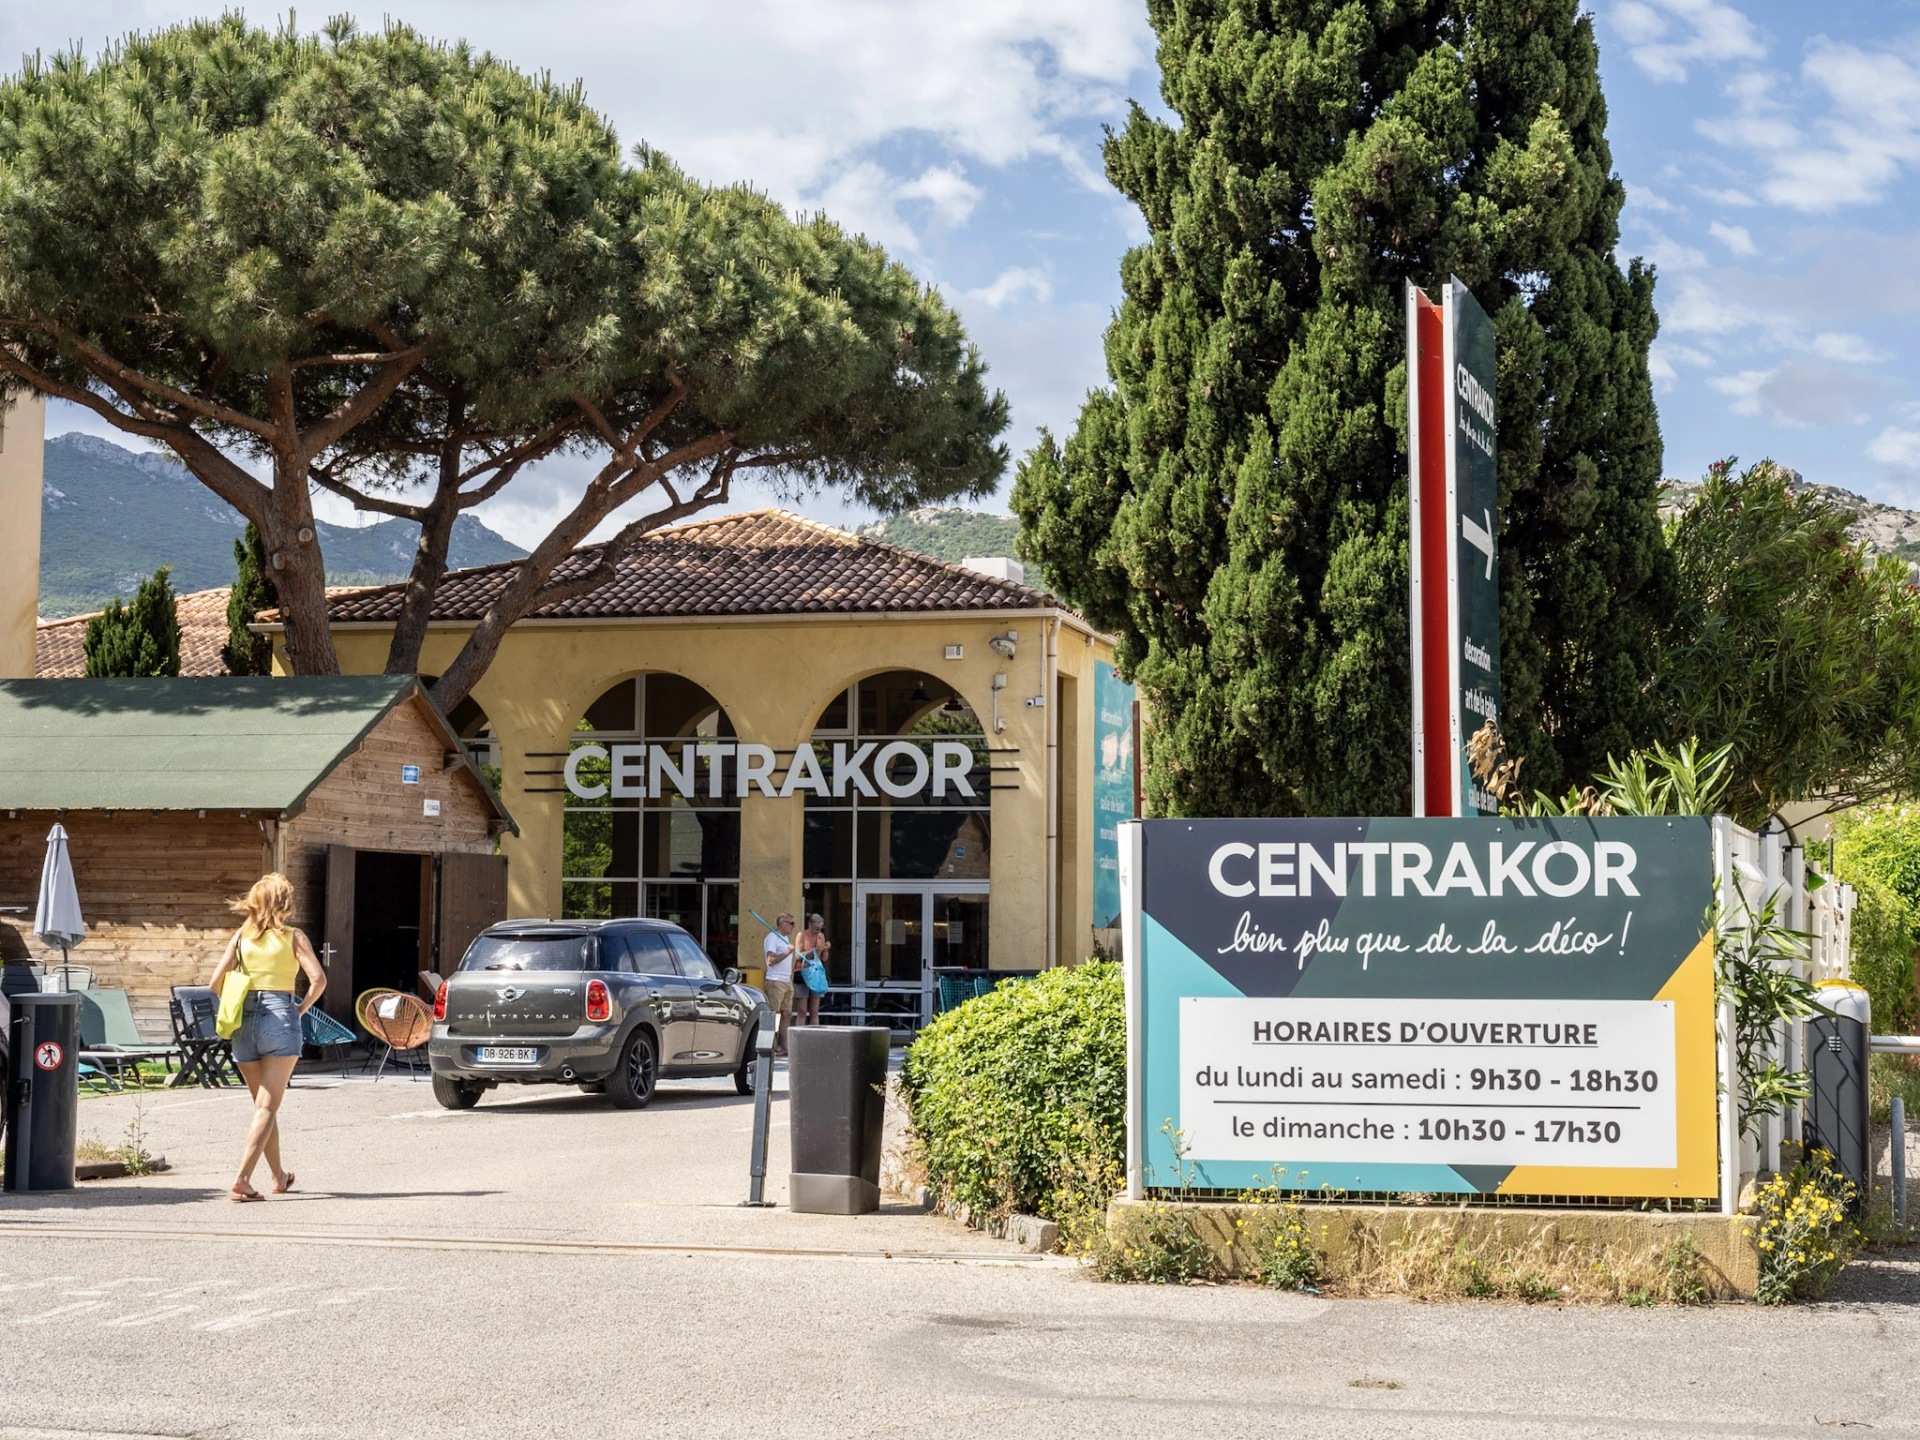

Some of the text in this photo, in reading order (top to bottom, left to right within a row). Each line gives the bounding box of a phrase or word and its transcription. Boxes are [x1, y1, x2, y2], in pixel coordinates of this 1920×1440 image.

[1457, 363, 1494, 430] CENTRAKOR
[1465, 635, 1491, 672] décoration
[564, 742, 977, 799] CENTRAKOR
[1208, 841, 1641, 897] CENTRAKOR
[1218, 911, 1287, 954] bien
[1293, 918, 1349, 970] plus
[1356, 932, 1410, 970] que
[1416, 923, 1461, 953] de
[1467, 920, 1517, 953] la
[1524, 917, 1613, 954] déco
[1254, 1021, 1597, 1044] HORAIRES D'OUVERTURE
[1196, 1066, 1228, 1087] du
[1238, 1066, 1302, 1088] lundi
[1312, 1072, 1342, 1088] au
[1352, 1069, 1445, 1089] samedi
[1470, 1069, 1541, 1090] 9h30
[1570, 1070, 1658, 1092] 18h30
[1233, 1116, 1254, 1137] le
[1263, 1117, 1395, 1139] dimanche
[1419, 1119, 1506, 1141] 10h30
[1534, 1121, 1621, 1143] 17h30
